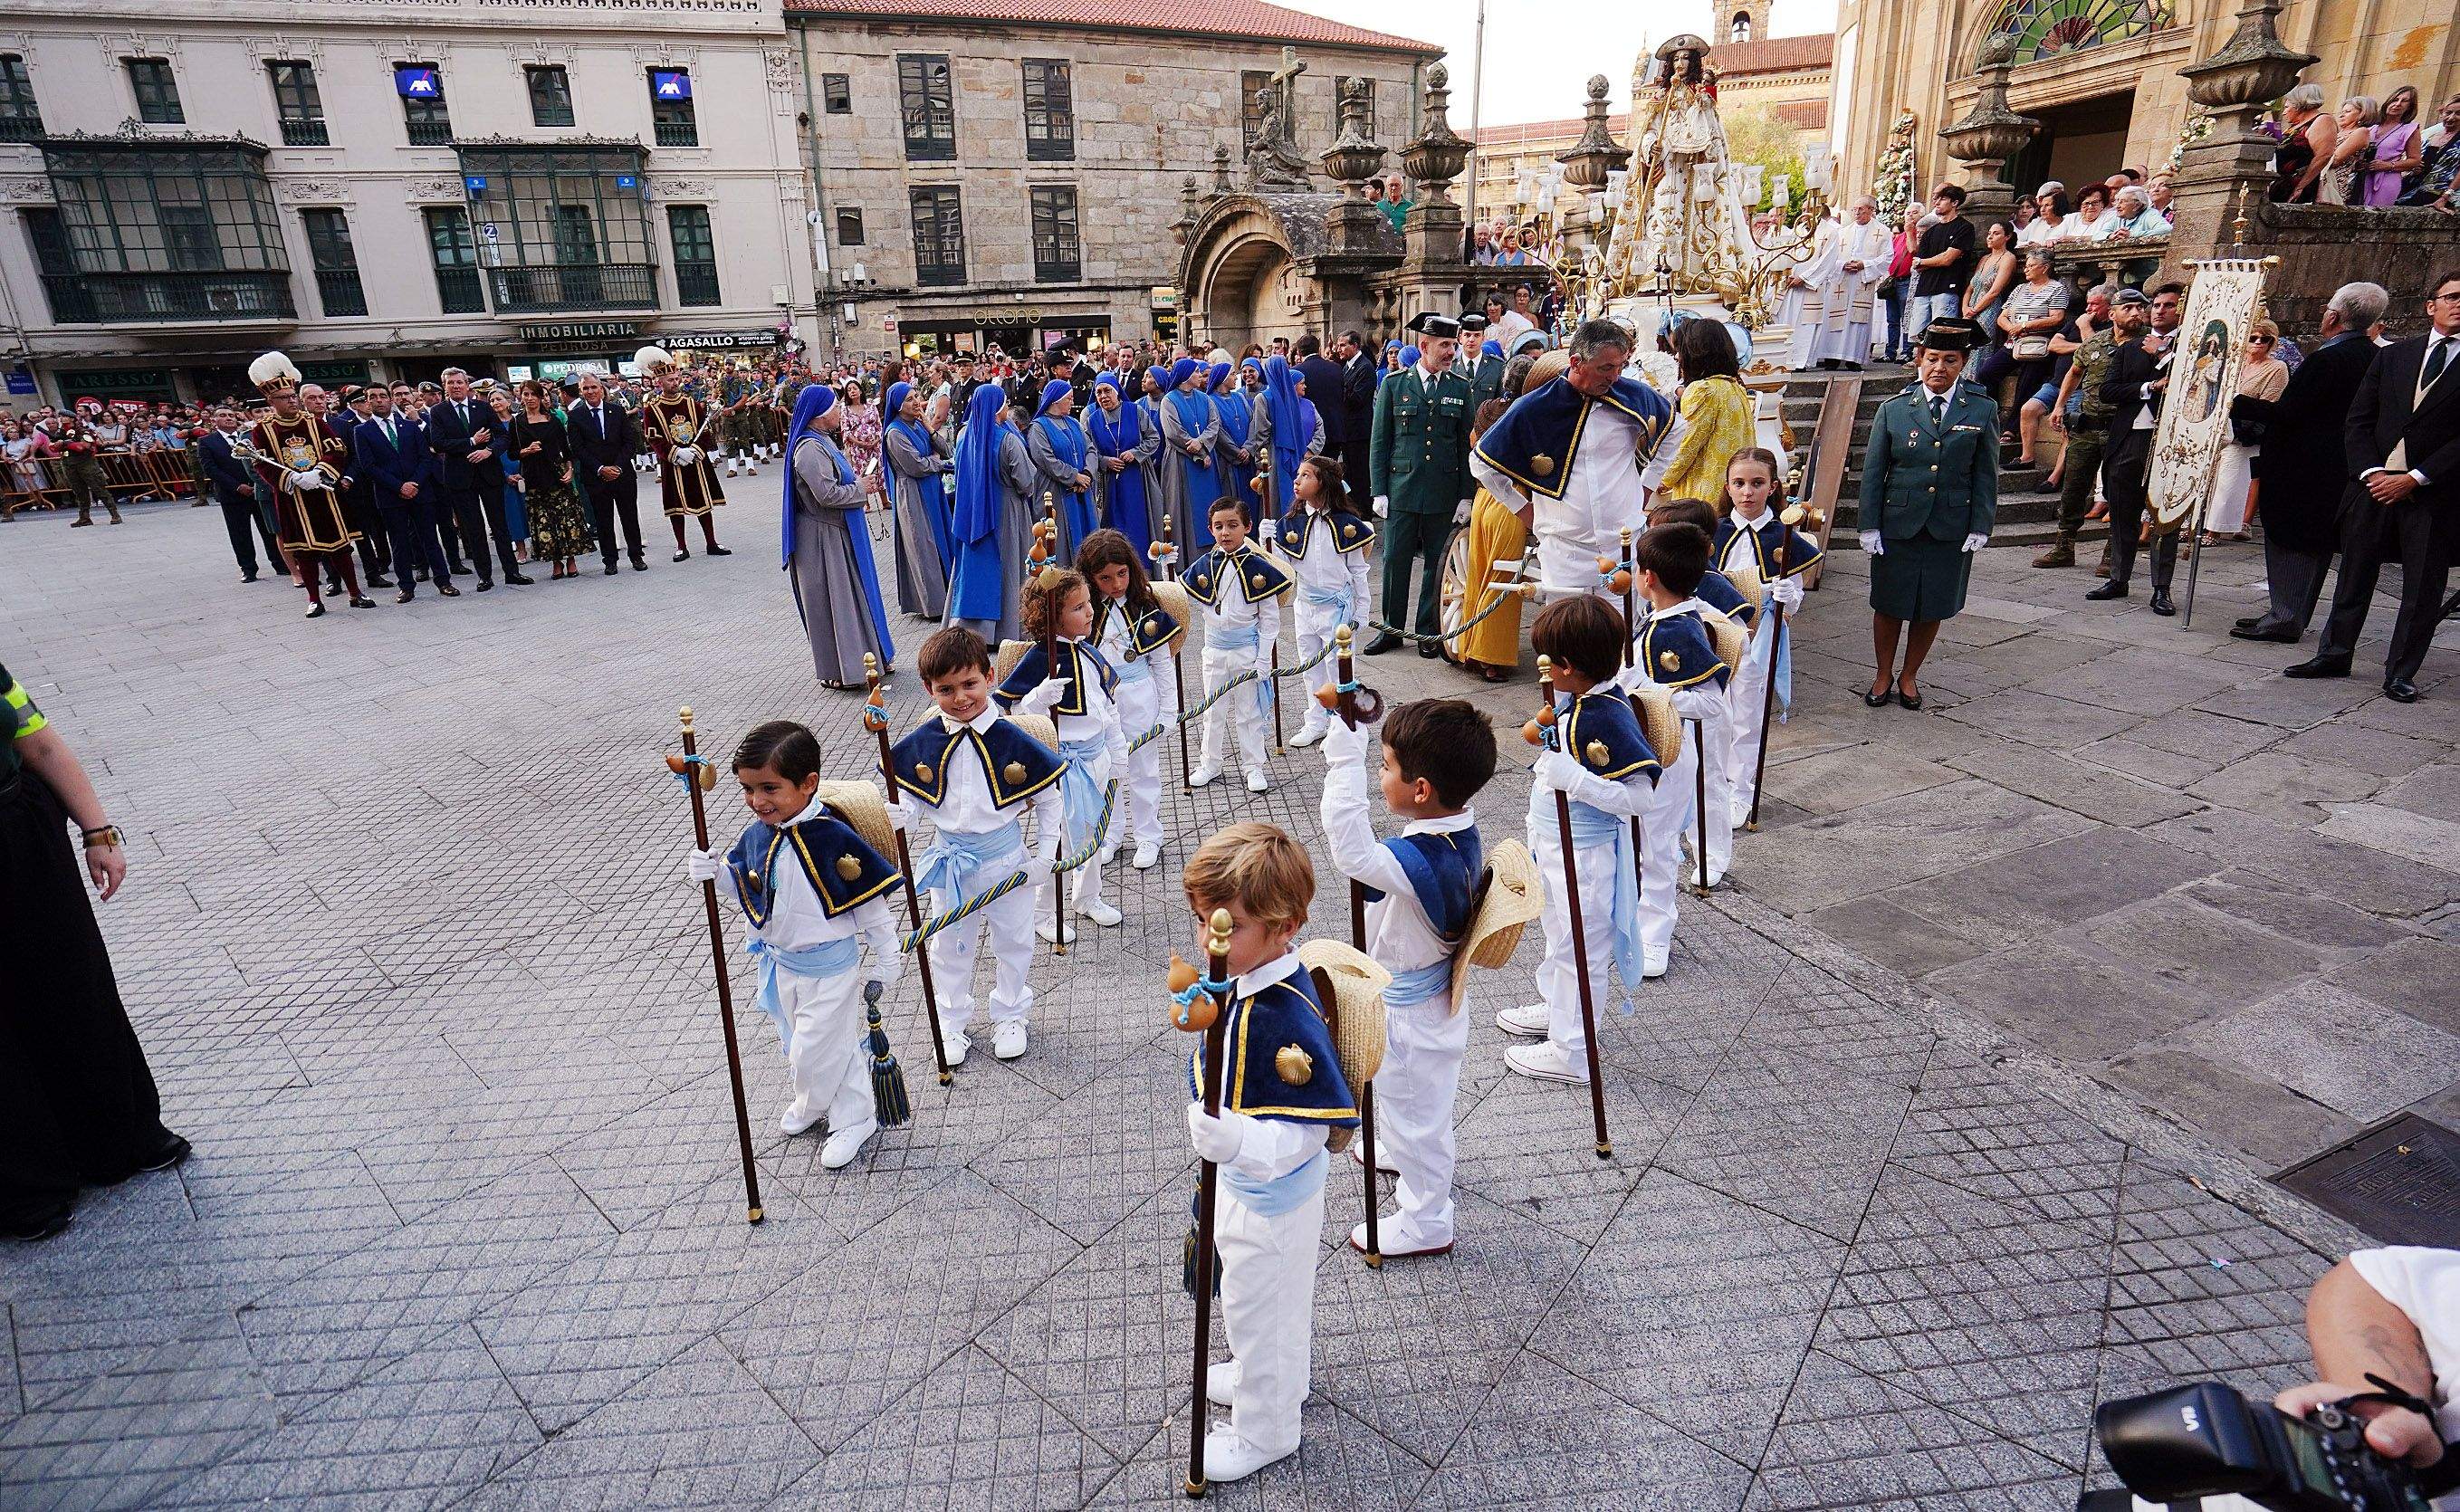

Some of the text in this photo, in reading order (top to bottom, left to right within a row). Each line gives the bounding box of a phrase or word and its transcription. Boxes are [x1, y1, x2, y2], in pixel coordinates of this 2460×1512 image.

[409, 80, 433, 91] AXA
[658, 82, 681, 94] AXA
[520, 323, 636, 339] INMOBILIARIA
[540, 340, 609, 352] PEDROSA
[669, 336, 733, 349] AGASALLO
[552, 362, 605, 373] PEDROSA
[74, 374, 155, 387] ARESSO
